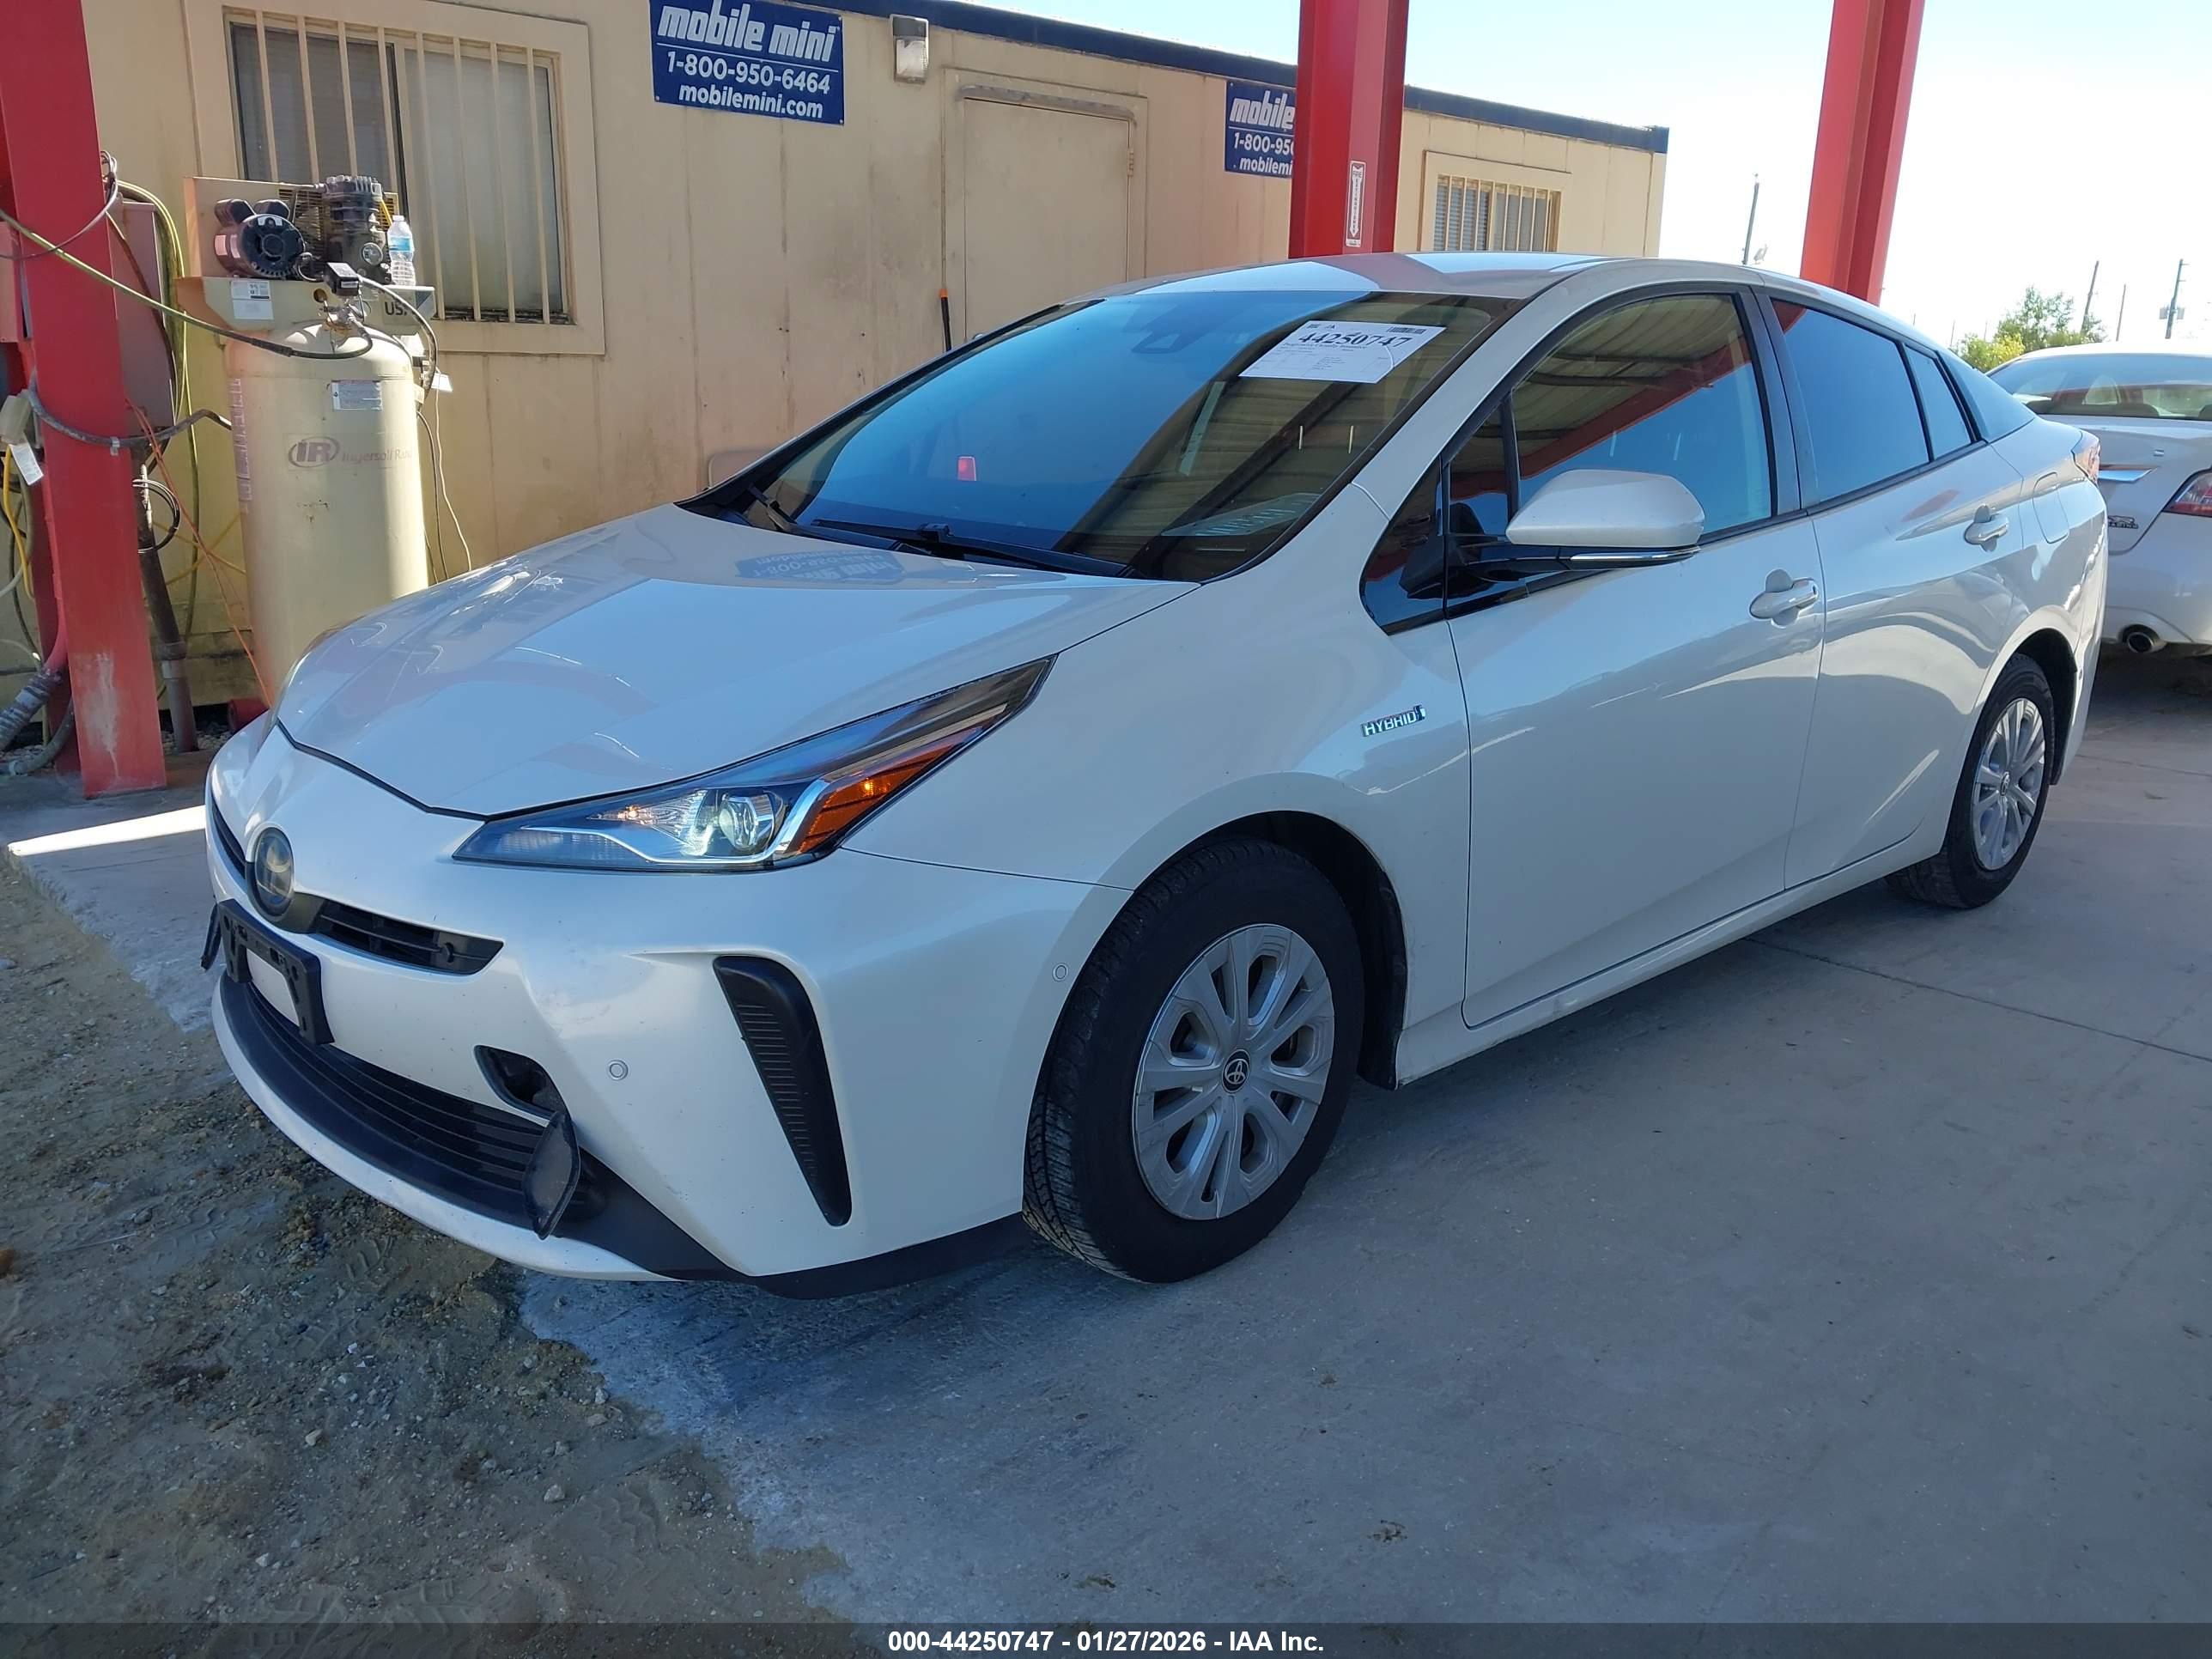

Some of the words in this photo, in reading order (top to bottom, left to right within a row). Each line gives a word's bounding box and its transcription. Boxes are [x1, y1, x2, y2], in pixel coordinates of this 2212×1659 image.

[658, 0, 765, 52] mobile
[769, 21, 836, 63] mini
[667, 51, 830, 94] 1-800-950-6464
[678, 84, 823, 118] mobilemini.com
[1230, 90, 1295, 129] mobile
[1298, 331, 1413, 348] 44250747
[1361, 710, 1418, 737] HYBRID
